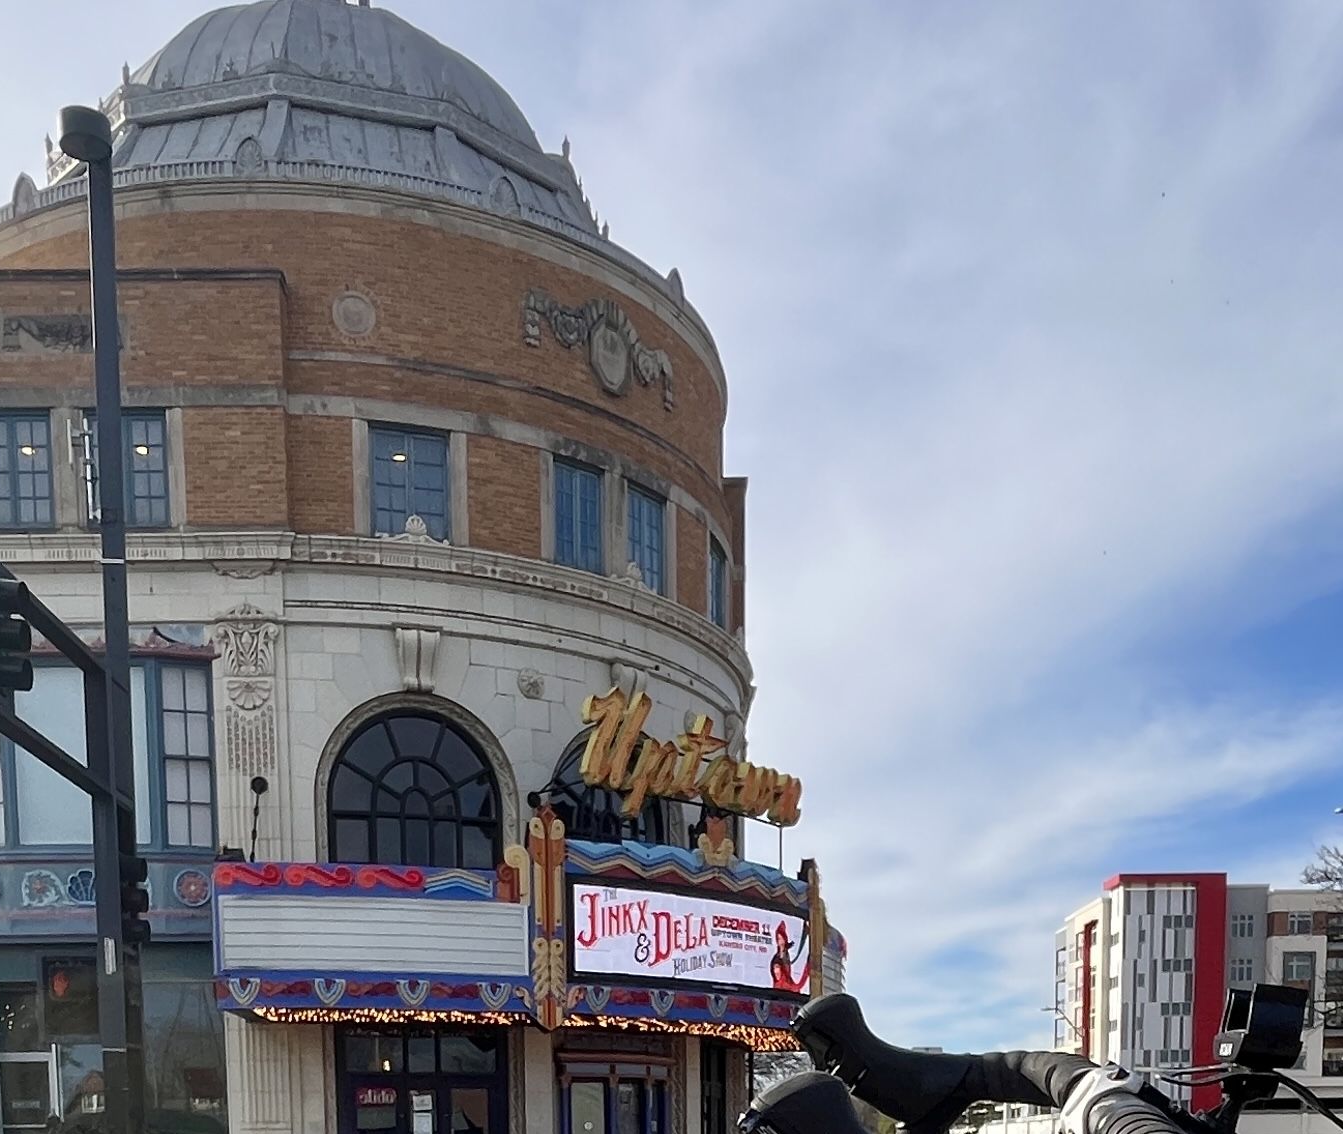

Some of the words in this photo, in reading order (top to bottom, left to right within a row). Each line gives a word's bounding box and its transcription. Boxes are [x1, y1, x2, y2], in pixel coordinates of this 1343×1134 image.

[580, 687, 803, 827] Uptown
[712, 915, 760, 934] DECEMBER
[634, 933, 651, 963] &
